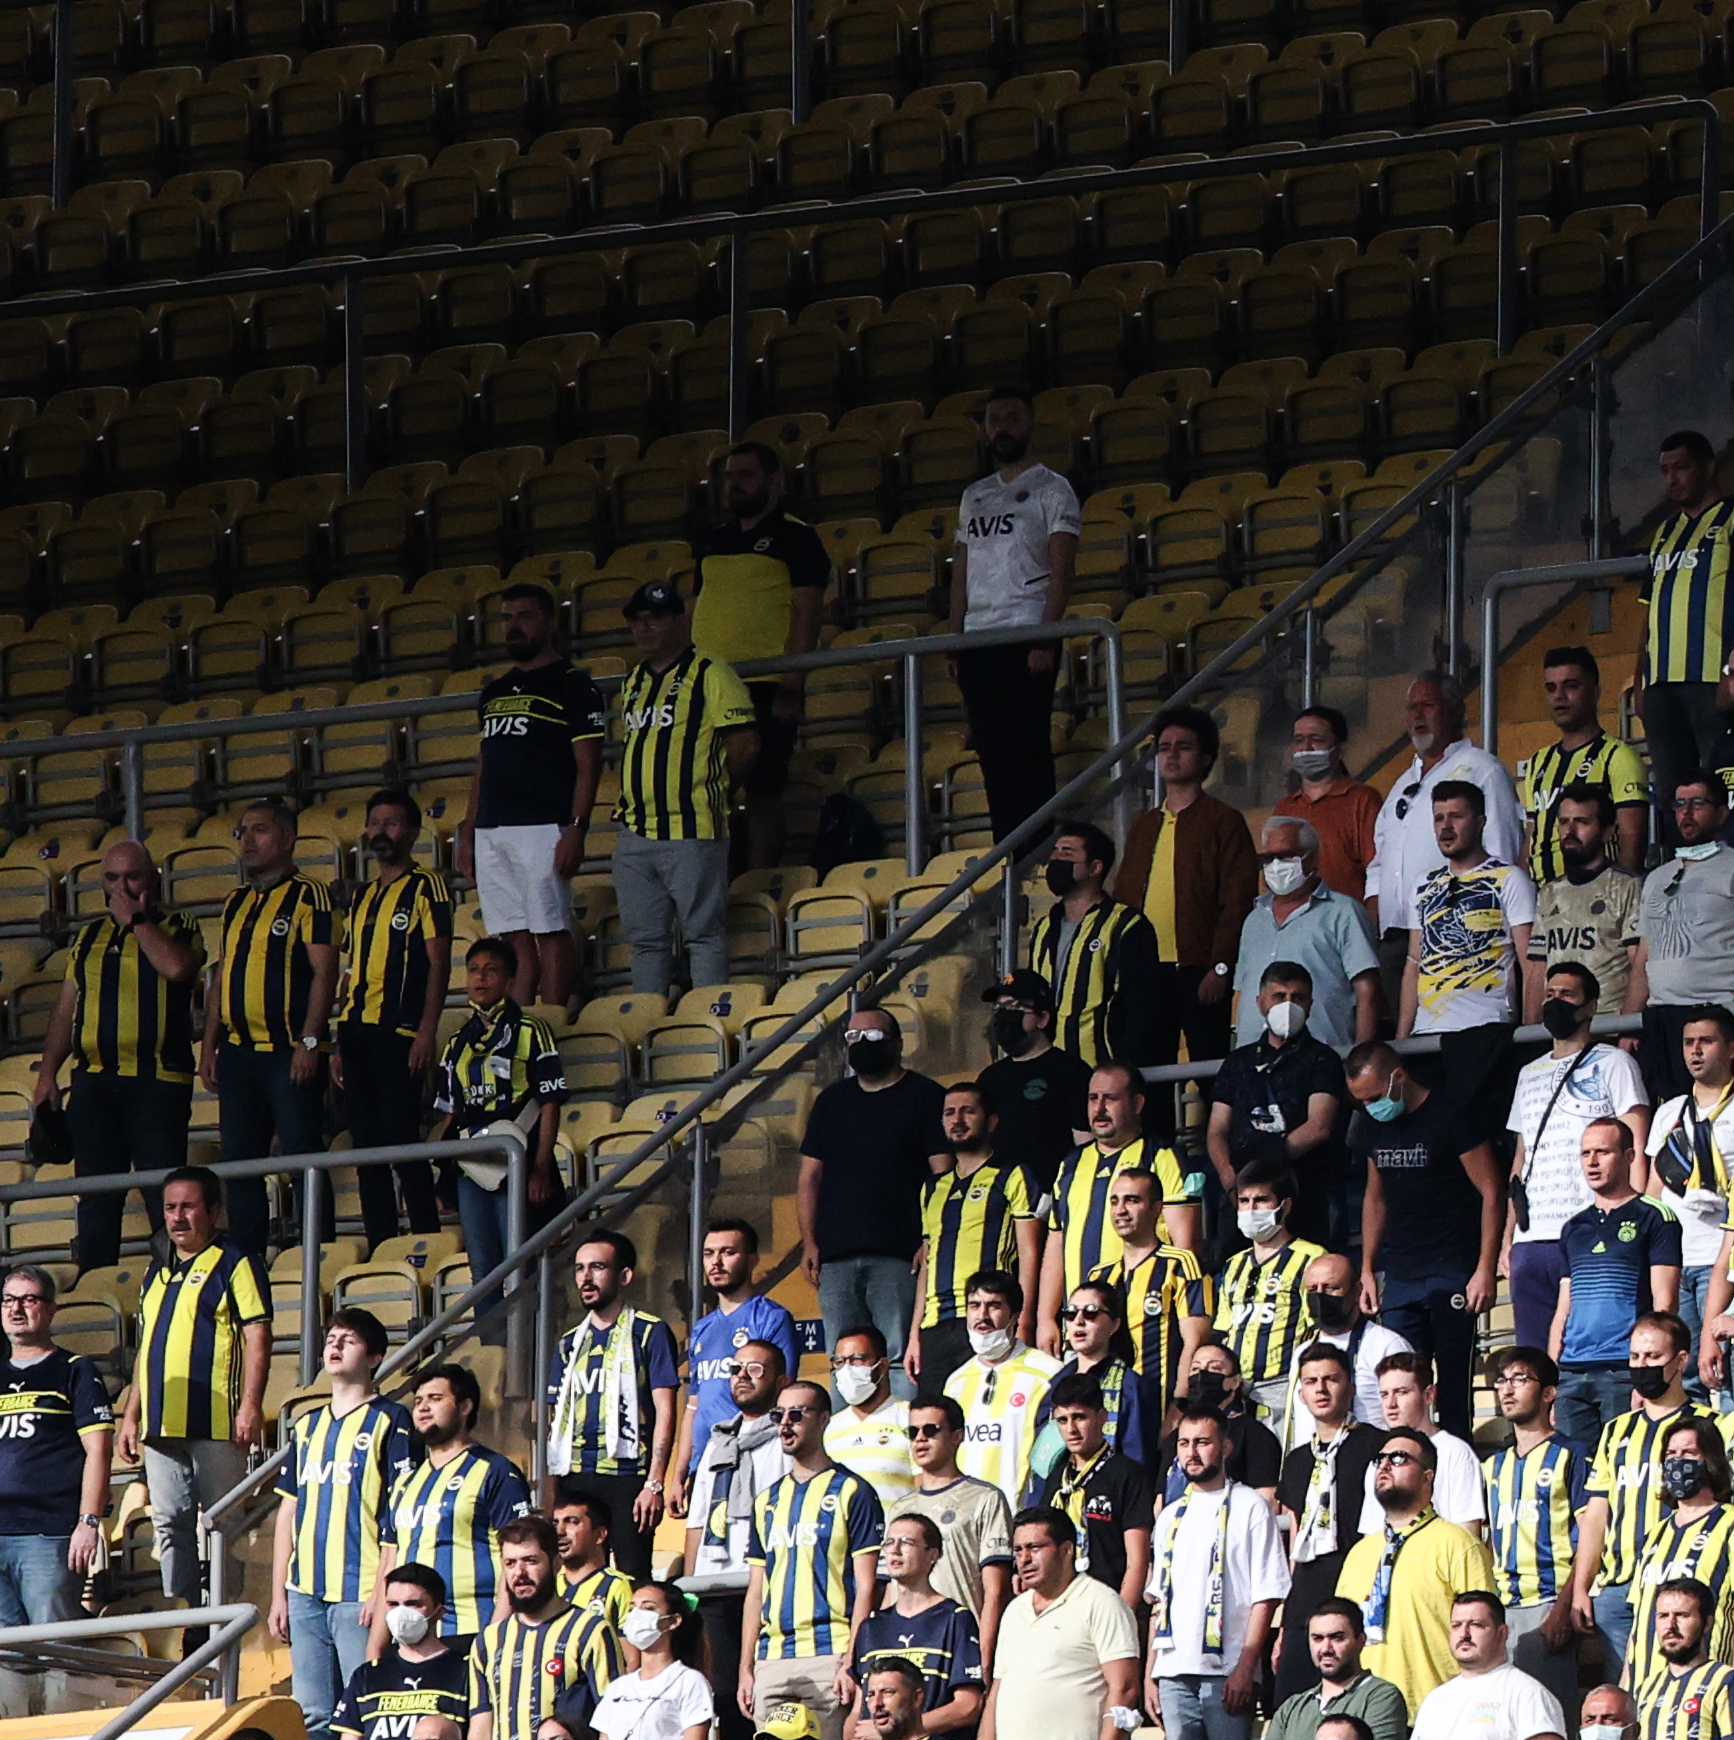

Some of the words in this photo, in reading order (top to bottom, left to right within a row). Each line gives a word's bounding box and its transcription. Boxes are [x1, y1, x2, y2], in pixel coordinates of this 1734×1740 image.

[966, 513, 1014, 536] AVIS
[1653, 550, 1698, 577] AVIS
[1547, 926, 1595, 950] AVIS
[964, 1436, 1001, 1457] vea
[300, 1461, 354, 1485] AVIS
[394, 1502, 442, 1528] AVIS
[766, 1525, 819, 1550] AVIS
